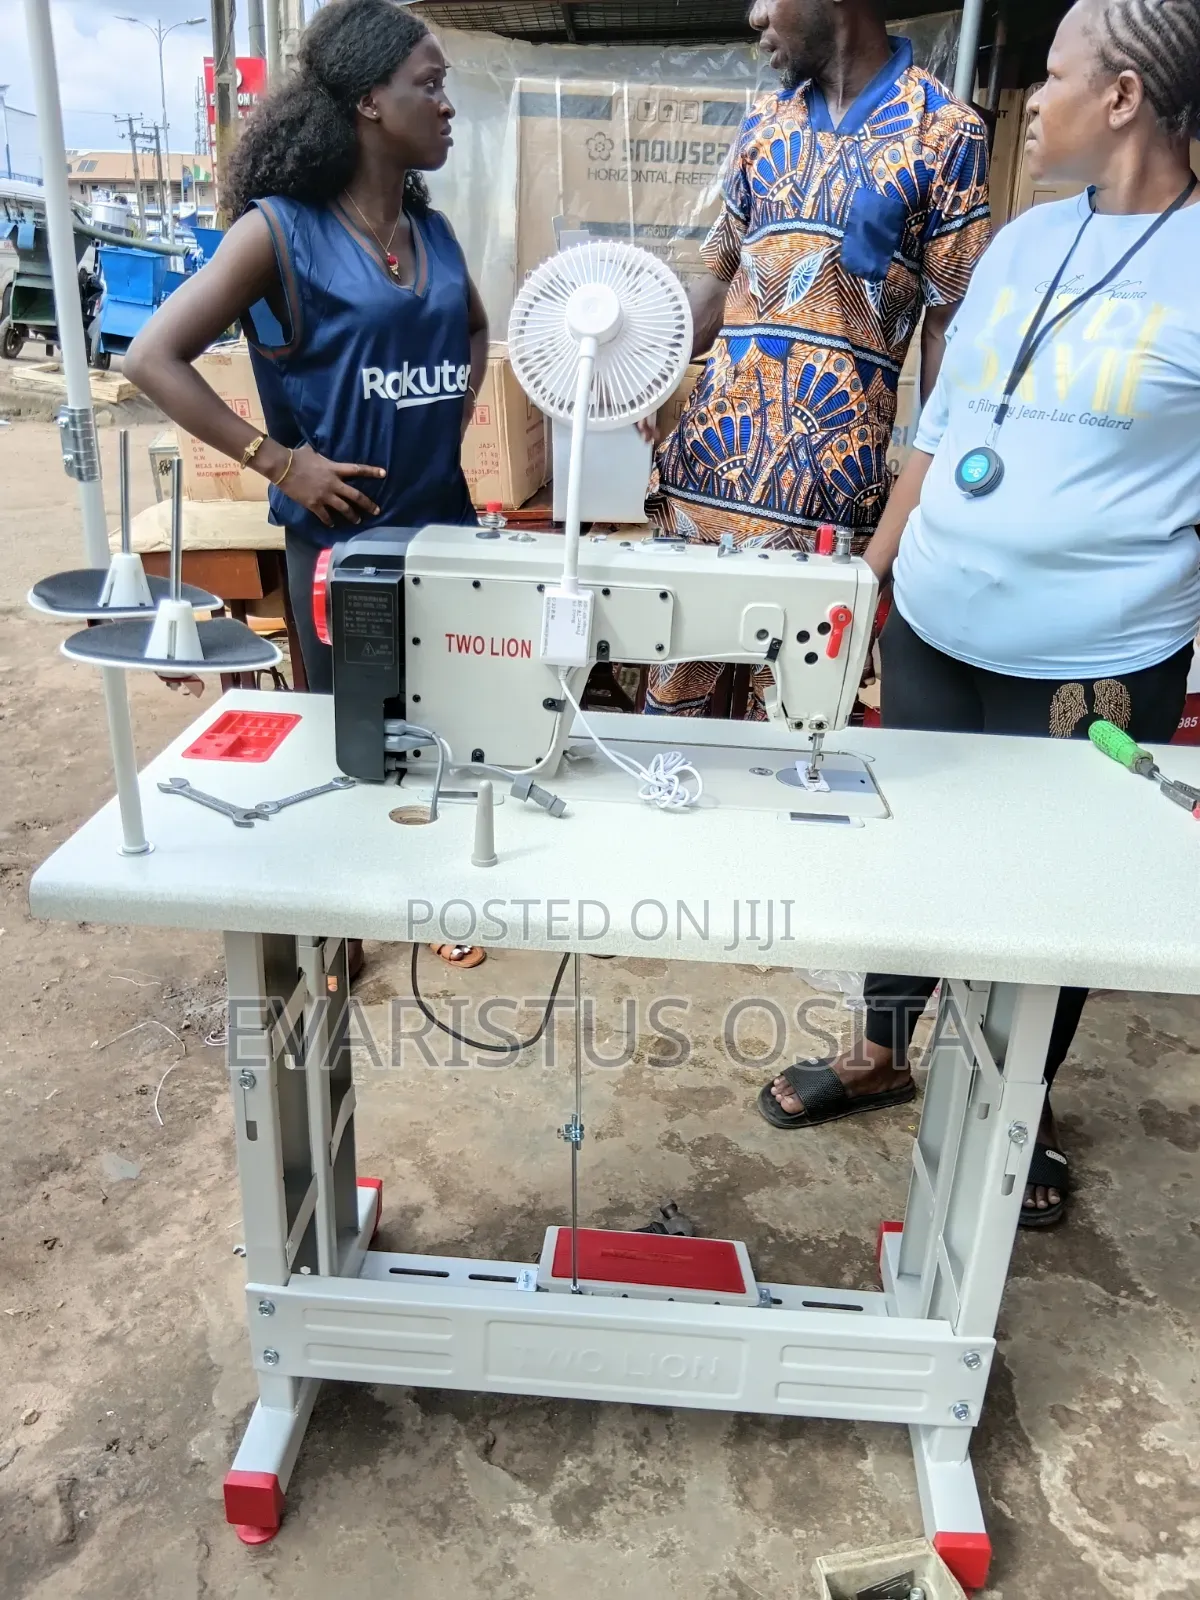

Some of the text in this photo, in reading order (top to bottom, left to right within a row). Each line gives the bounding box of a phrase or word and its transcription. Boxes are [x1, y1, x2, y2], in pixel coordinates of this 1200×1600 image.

[587, 167, 673, 184] HORIZONTAL
[643, 226, 671, 237] FRONT
[643, 244, 676, 256] AUTION
[975, 398, 1000, 414] film
[1016, 404, 1076, 424] Jean-Luc
[1078, 411, 1134, 431] Godard
[445, 633, 532, 659] TWO LION
[623, 1351, 720, 1380] LION
